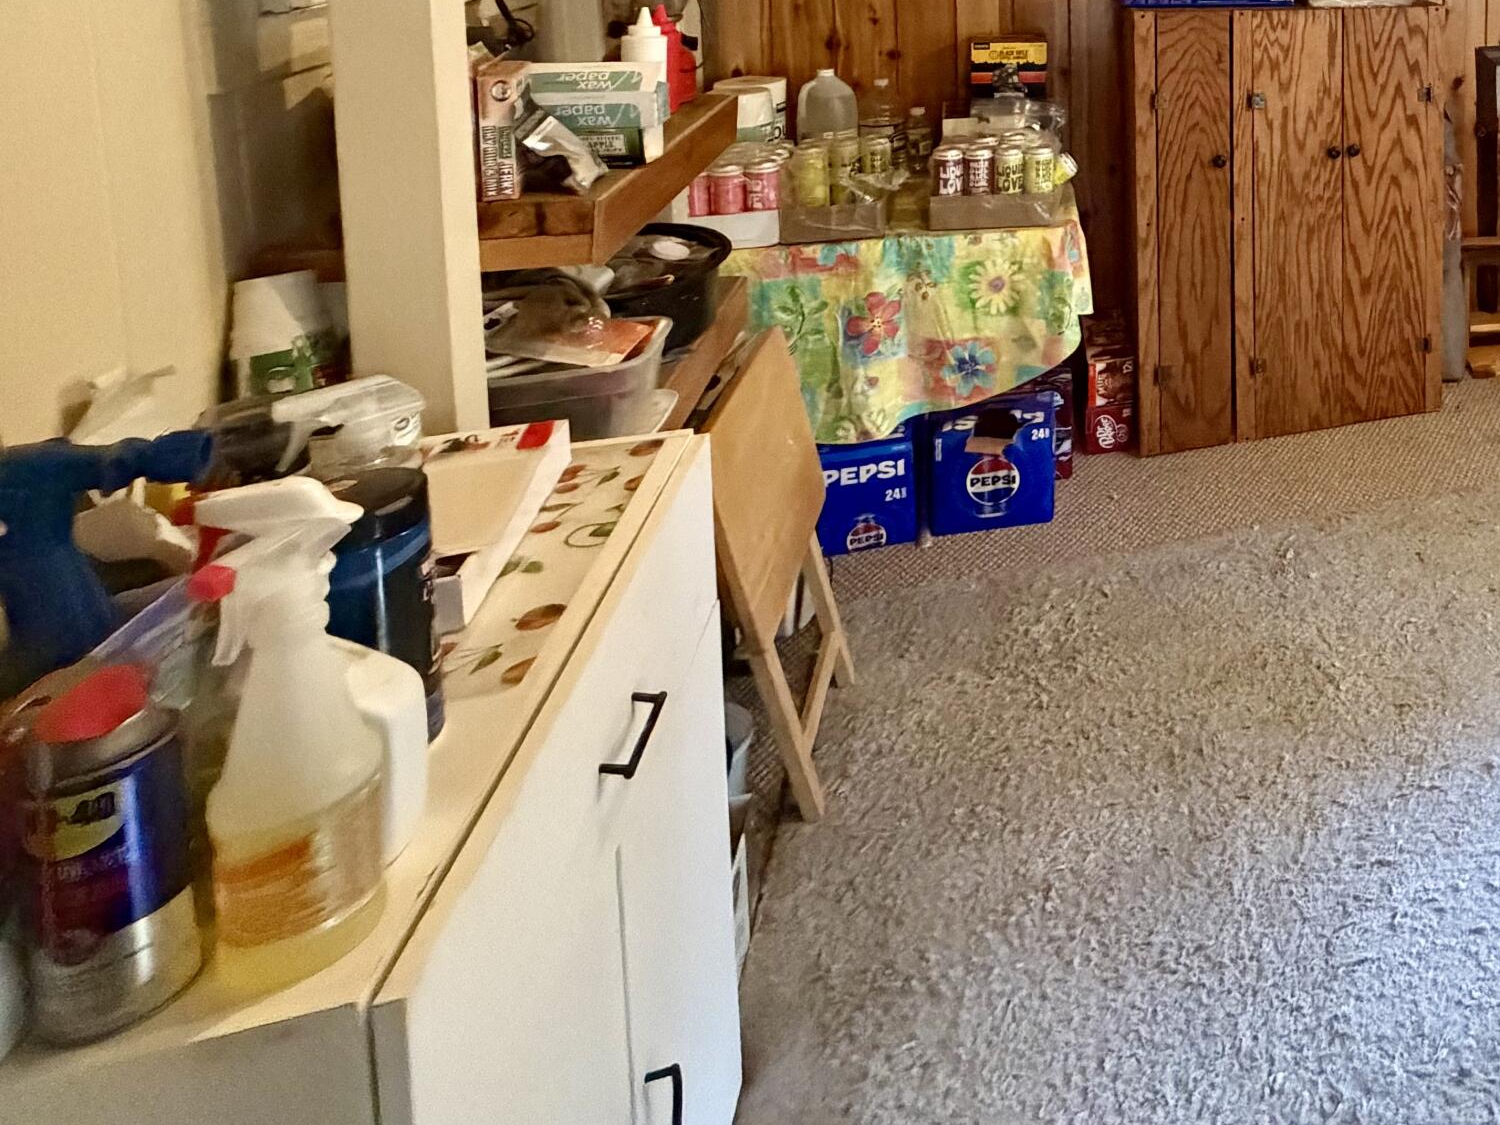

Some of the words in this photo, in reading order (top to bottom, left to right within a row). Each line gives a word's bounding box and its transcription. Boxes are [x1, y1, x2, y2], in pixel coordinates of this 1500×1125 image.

[556, 71, 611, 82] paper
[577, 80, 613, 92] wax
[554, 103, 606, 116] paper
[577, 115, 615, 128] wax
[498, 162, 514, 195] JERKY
[1031, 428, 1045, 441] 24
[824, 458, 906, 488] PEPSI
[970, 474, 1017, 488] PEPSI
[885, 489, 901, 502] 24
[849, 532, 885, 546] PEPSI
